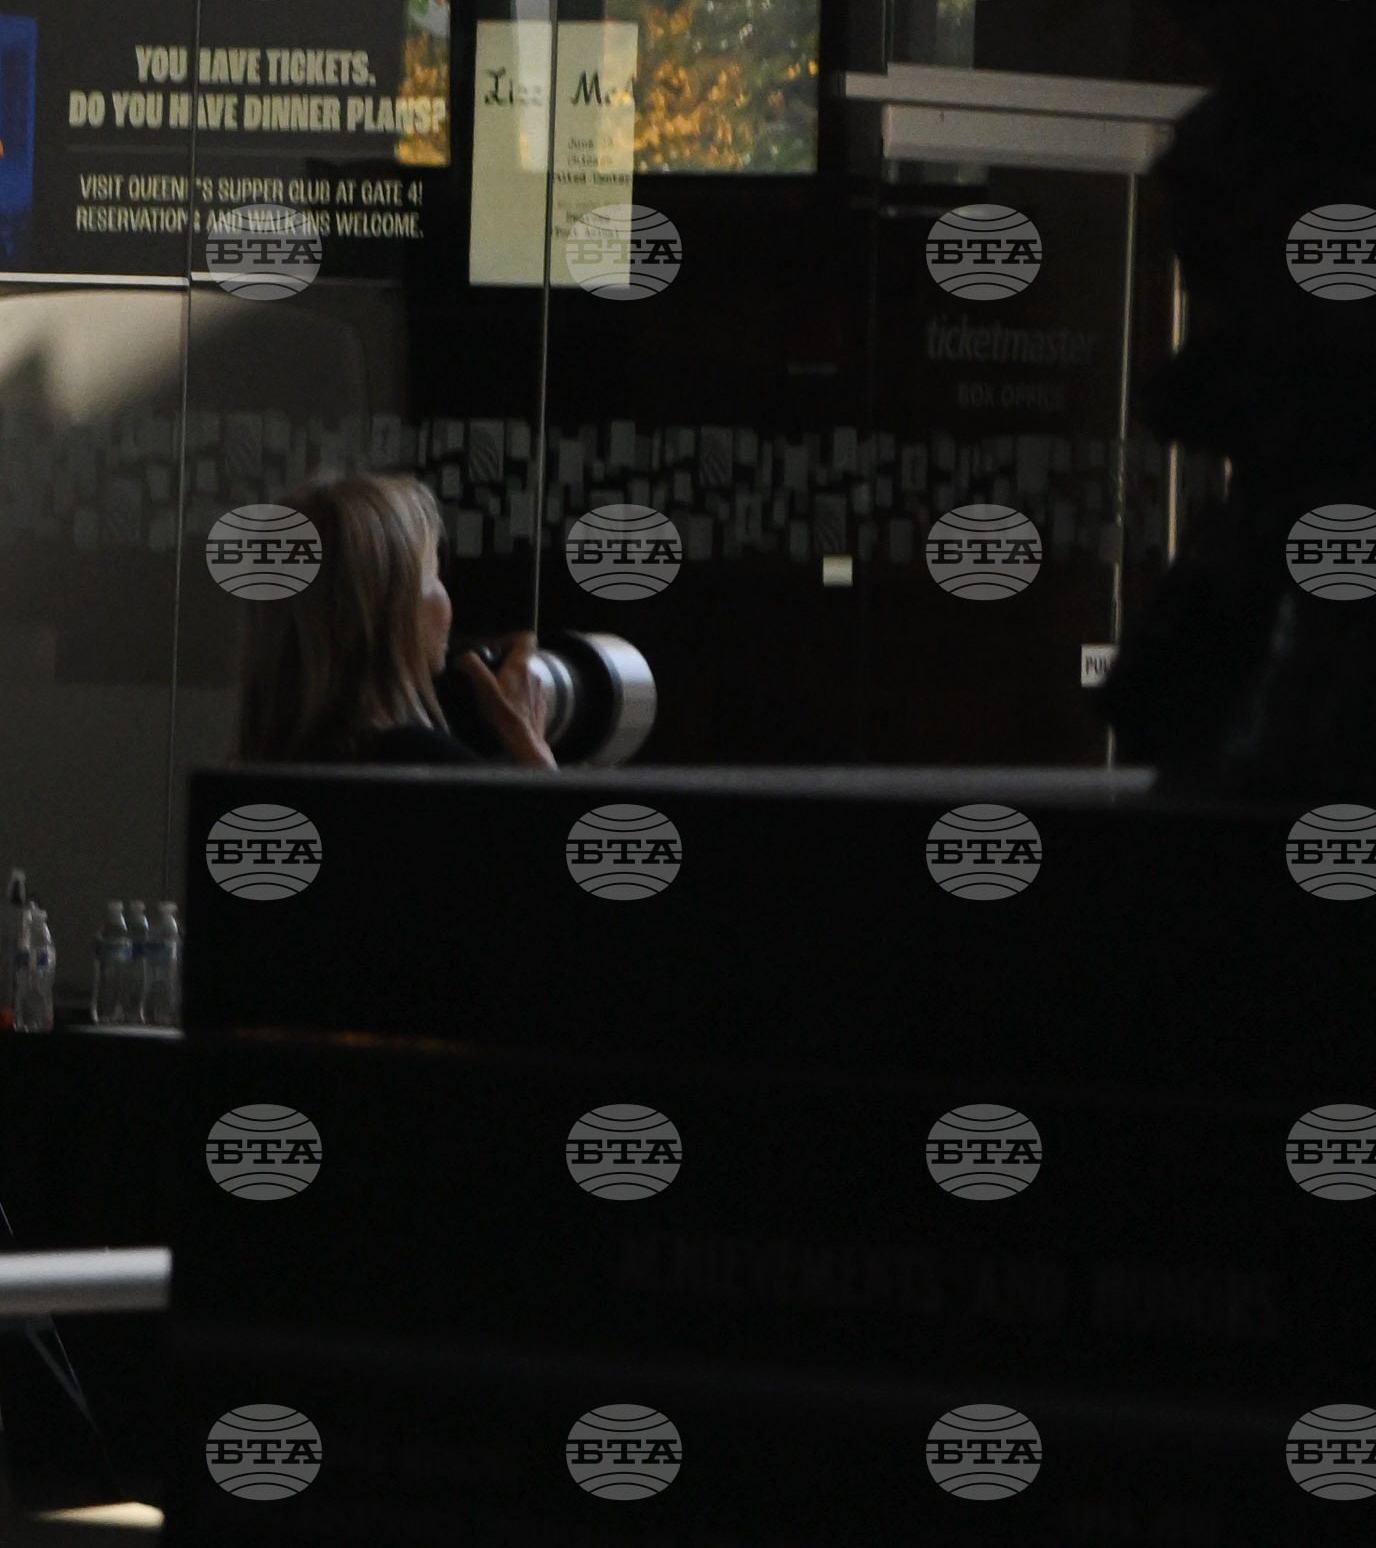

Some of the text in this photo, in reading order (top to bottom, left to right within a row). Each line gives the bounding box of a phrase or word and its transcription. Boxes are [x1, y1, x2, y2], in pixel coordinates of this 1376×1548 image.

[135, 44, 188, 84] YOU
[266, 48, 377, 87] TICKETS.
[69, 90, 106, 129] DO
[112, 91, 164, 129] YOU
[244, 93, 341, 131] DINNER
[347, 95, 446, 134] PLANS?
[80, 174, 423, 206] VISIT QUEENI'S SUPPER CLUB AT GATE 4!
[206, 208, 243, 235] AND
[335, 211, 425, 239] WELCOME.
[926, 312, 1097, 364] ticketmaster
